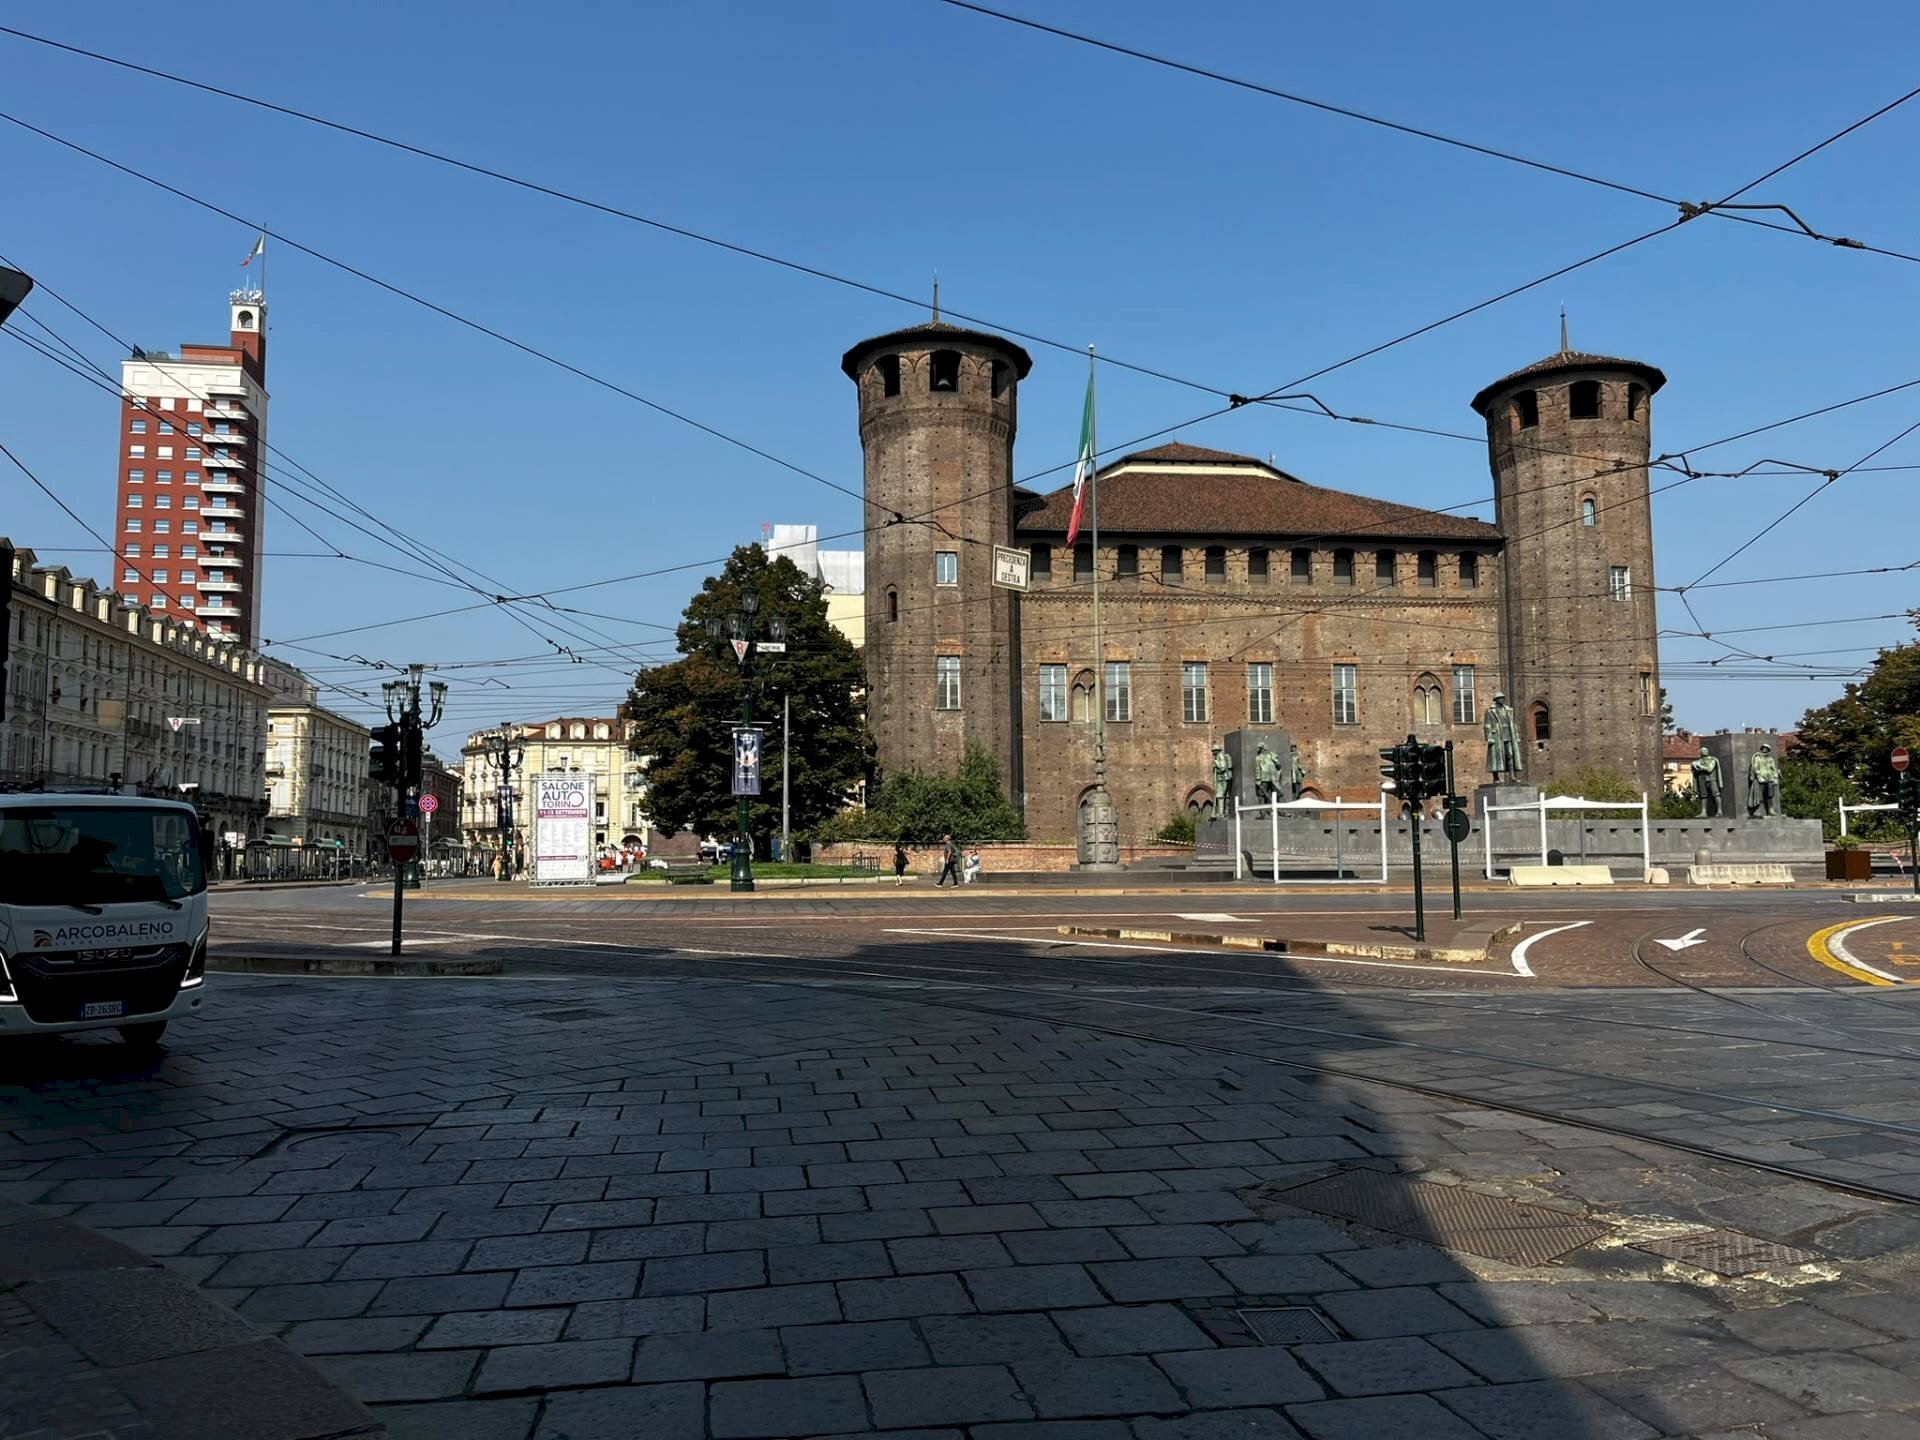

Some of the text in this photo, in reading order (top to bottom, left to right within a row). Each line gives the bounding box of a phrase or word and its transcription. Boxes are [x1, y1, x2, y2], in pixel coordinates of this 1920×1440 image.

[998, 552, 1025, 566] PRECEDENZA
[1001, 571, 1020, 583] DESTRA
[542, 782, 584, 790] SALONE
[55, 922, 174, 940] ARCOBALENO
[78, 948, 132, 960] ISUZU
